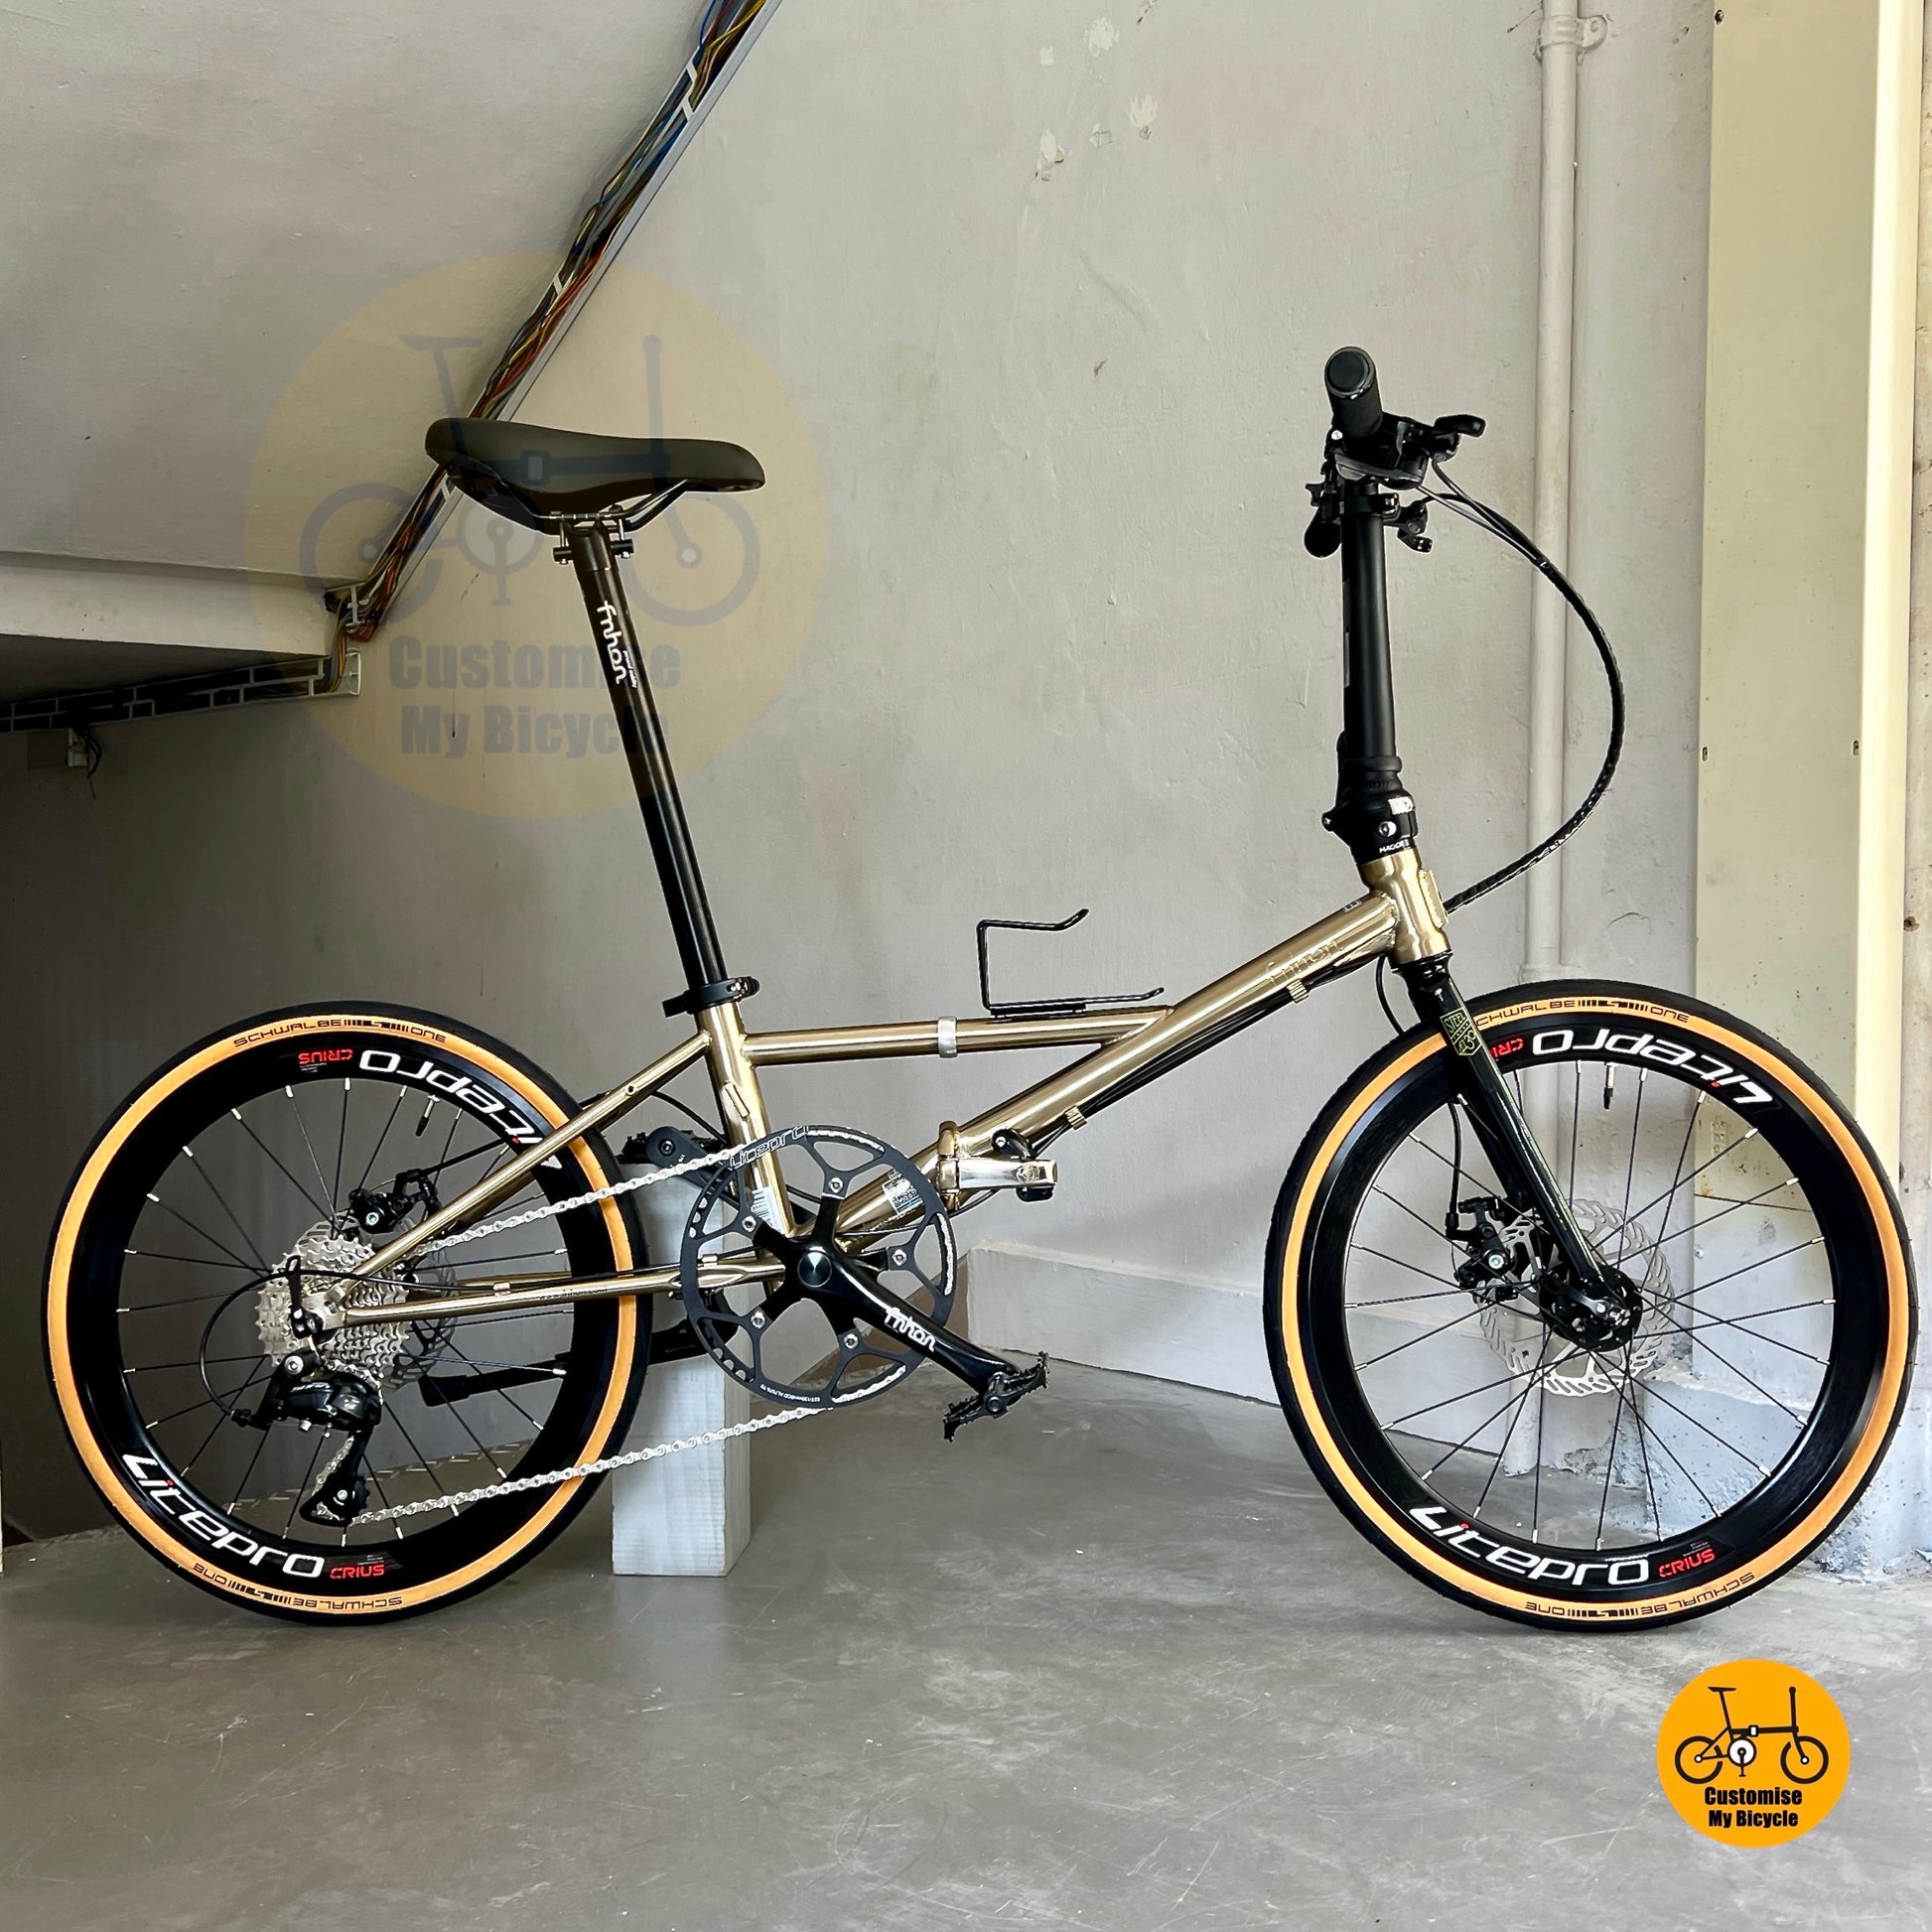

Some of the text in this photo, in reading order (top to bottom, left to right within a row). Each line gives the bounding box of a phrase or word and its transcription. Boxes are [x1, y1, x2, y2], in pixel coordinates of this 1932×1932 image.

[1445, 1013, 1466, 1034] STEEL
[1475, 1000, 1690, 1028] CHWALBE ONE
[233, 1019, 447, 1047] SCHWALBE ONE
[298, 1048, 353, 1064] CRIUS
[1489, 1037, 1524, 1058] CRI
[122, 1453, 326, 1579] Litepro
[1410, 1506, 1650, 1586] Litepro
[330, 1564, 386, 1580] CRIUS
[1658, 1548, 1717, 1579] CRIUS
[193, 1563, 403, 1610] SCHWALBE ONE
[1525, 1572, 1755, 1616] SCHWALBE ONE
